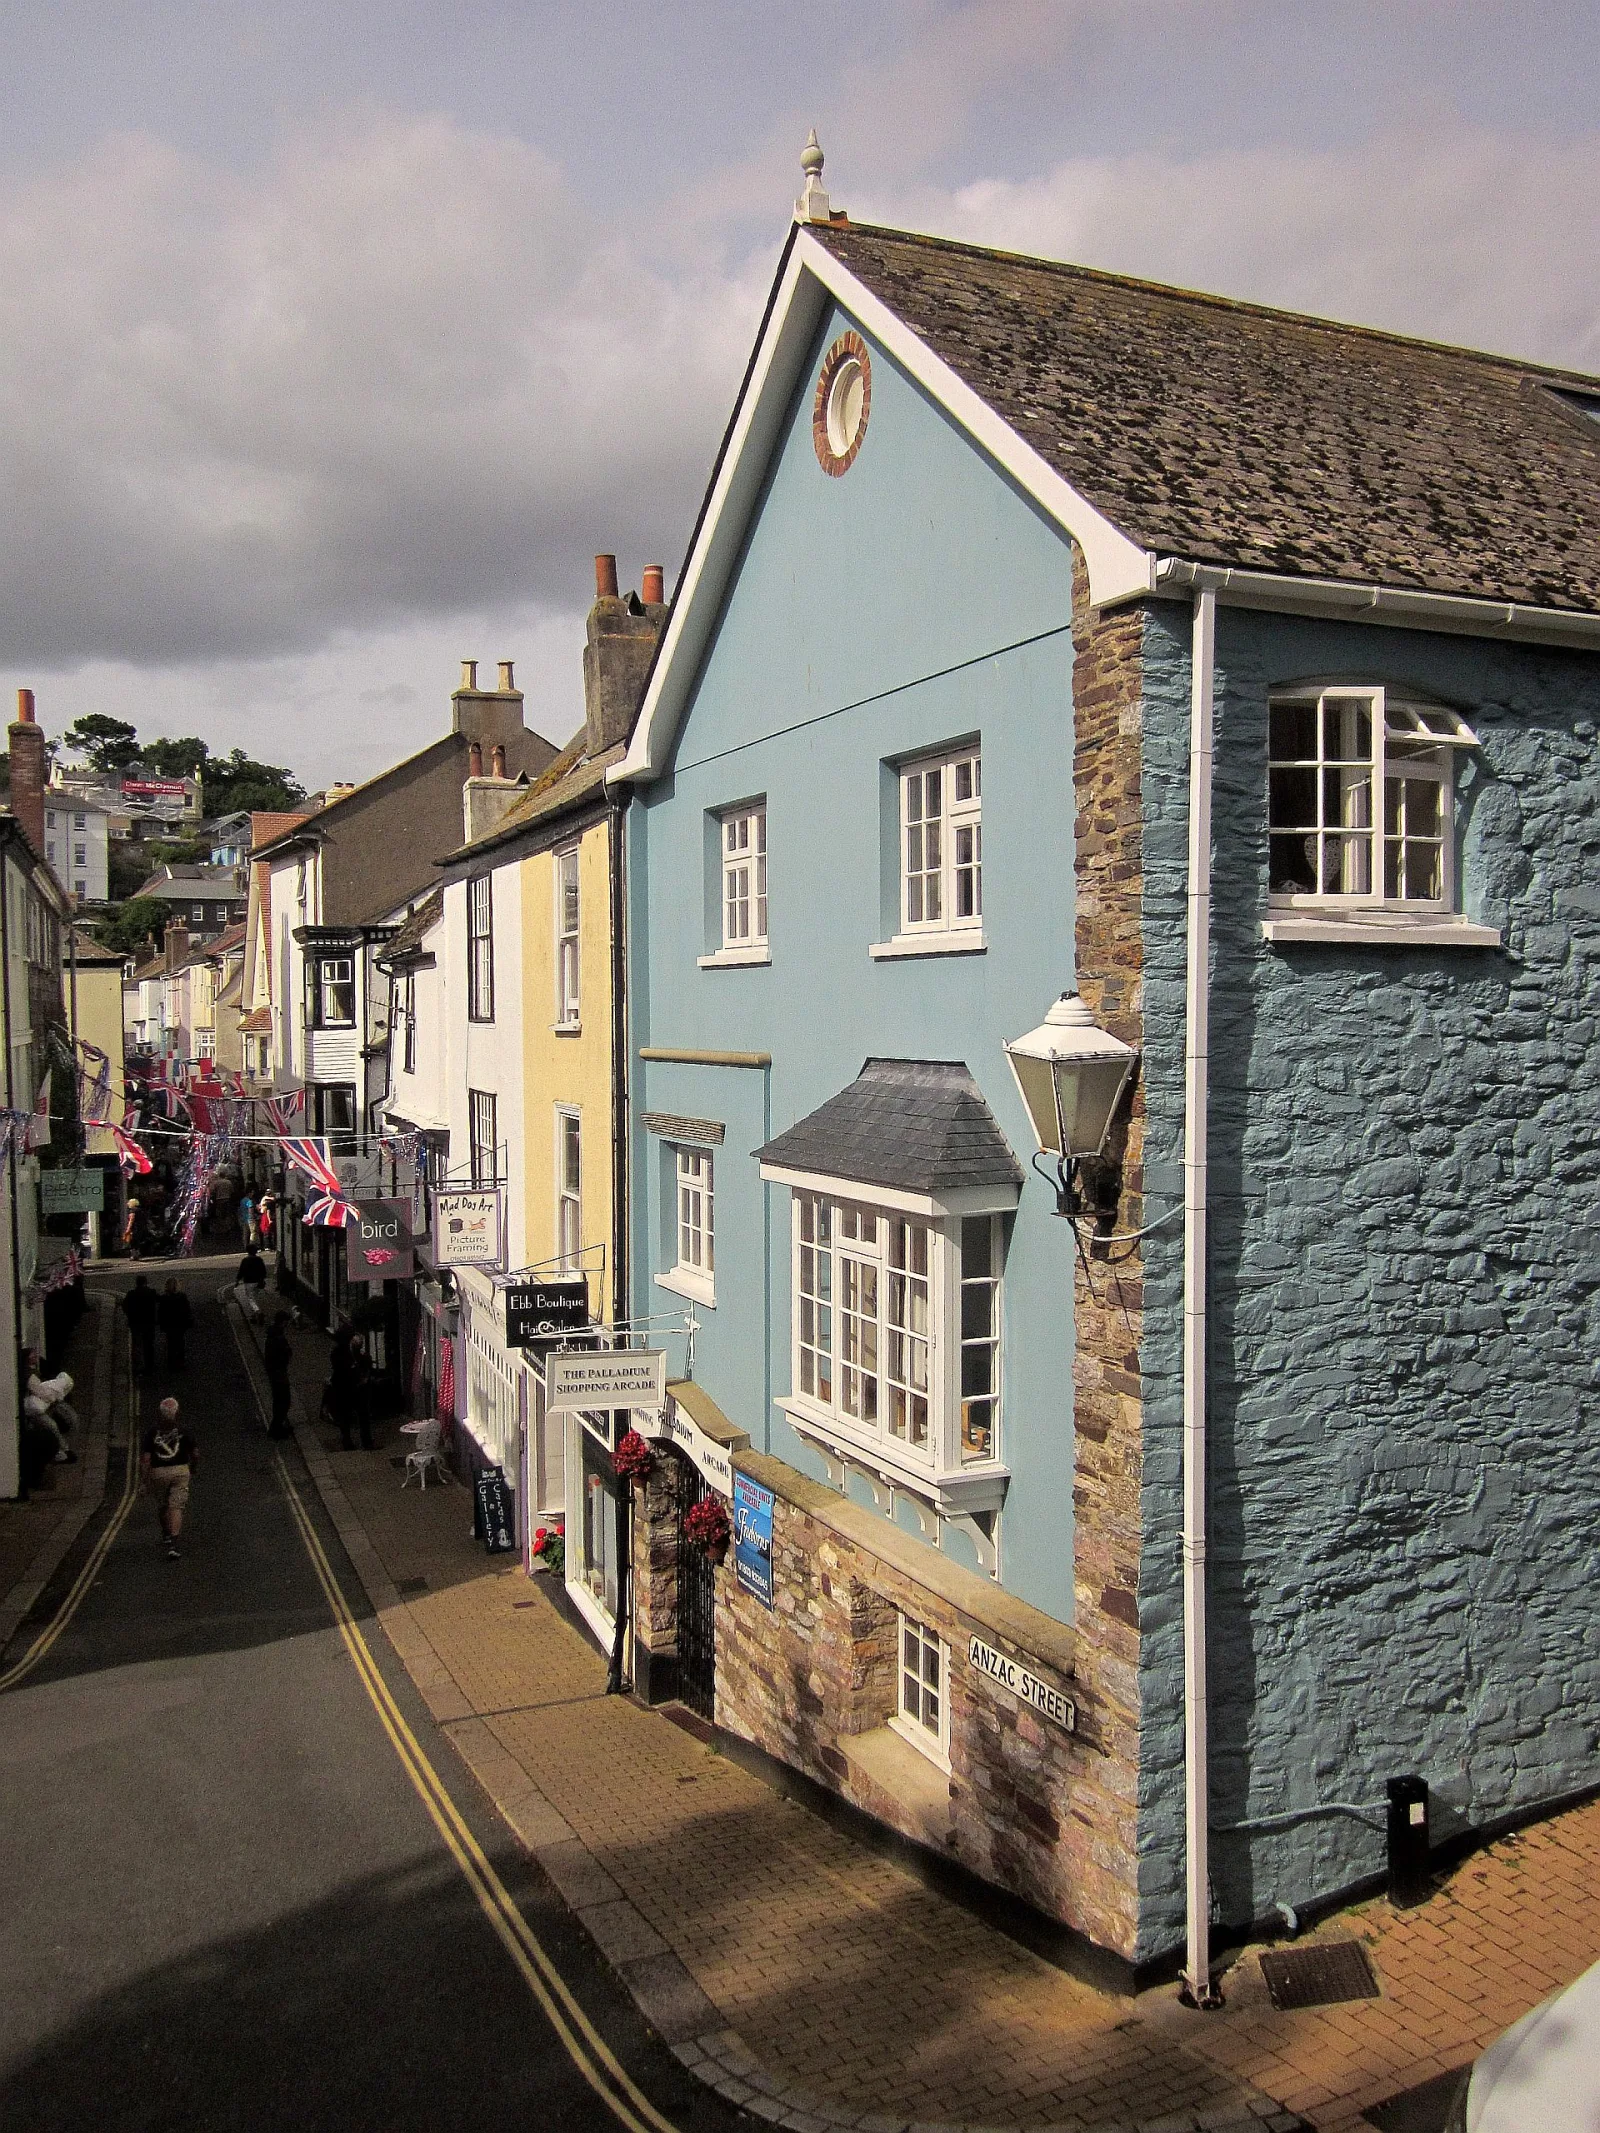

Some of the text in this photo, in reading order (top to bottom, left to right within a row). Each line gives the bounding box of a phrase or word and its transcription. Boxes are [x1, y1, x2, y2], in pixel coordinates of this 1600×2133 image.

[440, 1196, 494, 1215] Mad Dog Art
[361, 1220, 398, 1239] bird
[447, 1244, 489, 1253] Framing
[450, 1235, 486, 1244] Picture
[510, 1295, 532, 1310] Ebb
[536, 1293, 585, 1310] Boutique
[520, 1322, 540, 1335] Hai
[563, 1367, 651, 1380] THE PALLADIUM
[556, 1380, 656, 1395] SHOPPING ARCADE
[701, 1450, 730, 1478] ARCADE
[493, 1483, 504, 1523] Cards
[479, 1485, 494, 1547] Gallery
[971, 1641, 1072, 1725] ANZAC STREET
